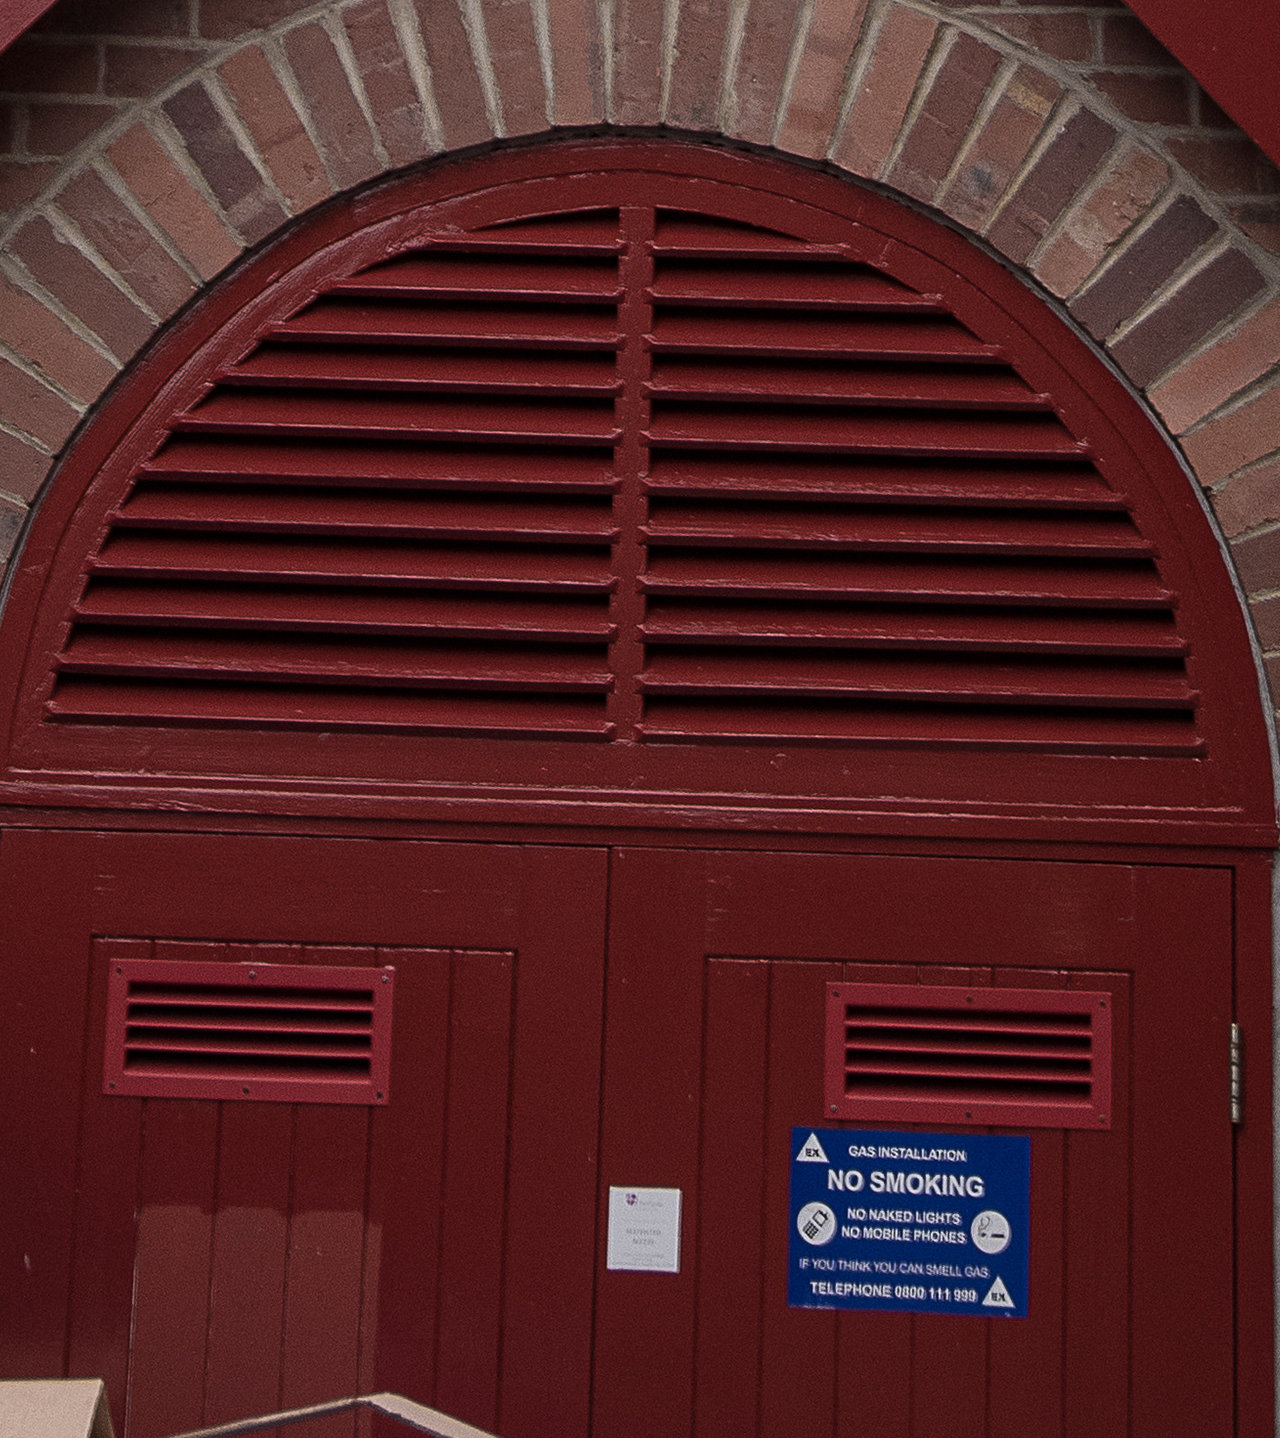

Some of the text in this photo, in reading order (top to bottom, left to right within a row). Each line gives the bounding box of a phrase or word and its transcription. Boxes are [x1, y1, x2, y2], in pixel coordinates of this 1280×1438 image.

[805, 1148, 820, 1157] EX
[848, 1145, 967, 1162] GAS INSTALLATION
[827, 1169, 985, 1197] NO SMOKING
[847, 1207, 961, 1225] NO NAKED LIGHTS
[841, 1226, 967, 1244] NO MOBILE PHONES
[799, 1258, 989, 1278] IF YOU THINK YOU CAN SMELL GAS
[810, 1281, 977, 1302] TELEPHONE 0800 111 999
